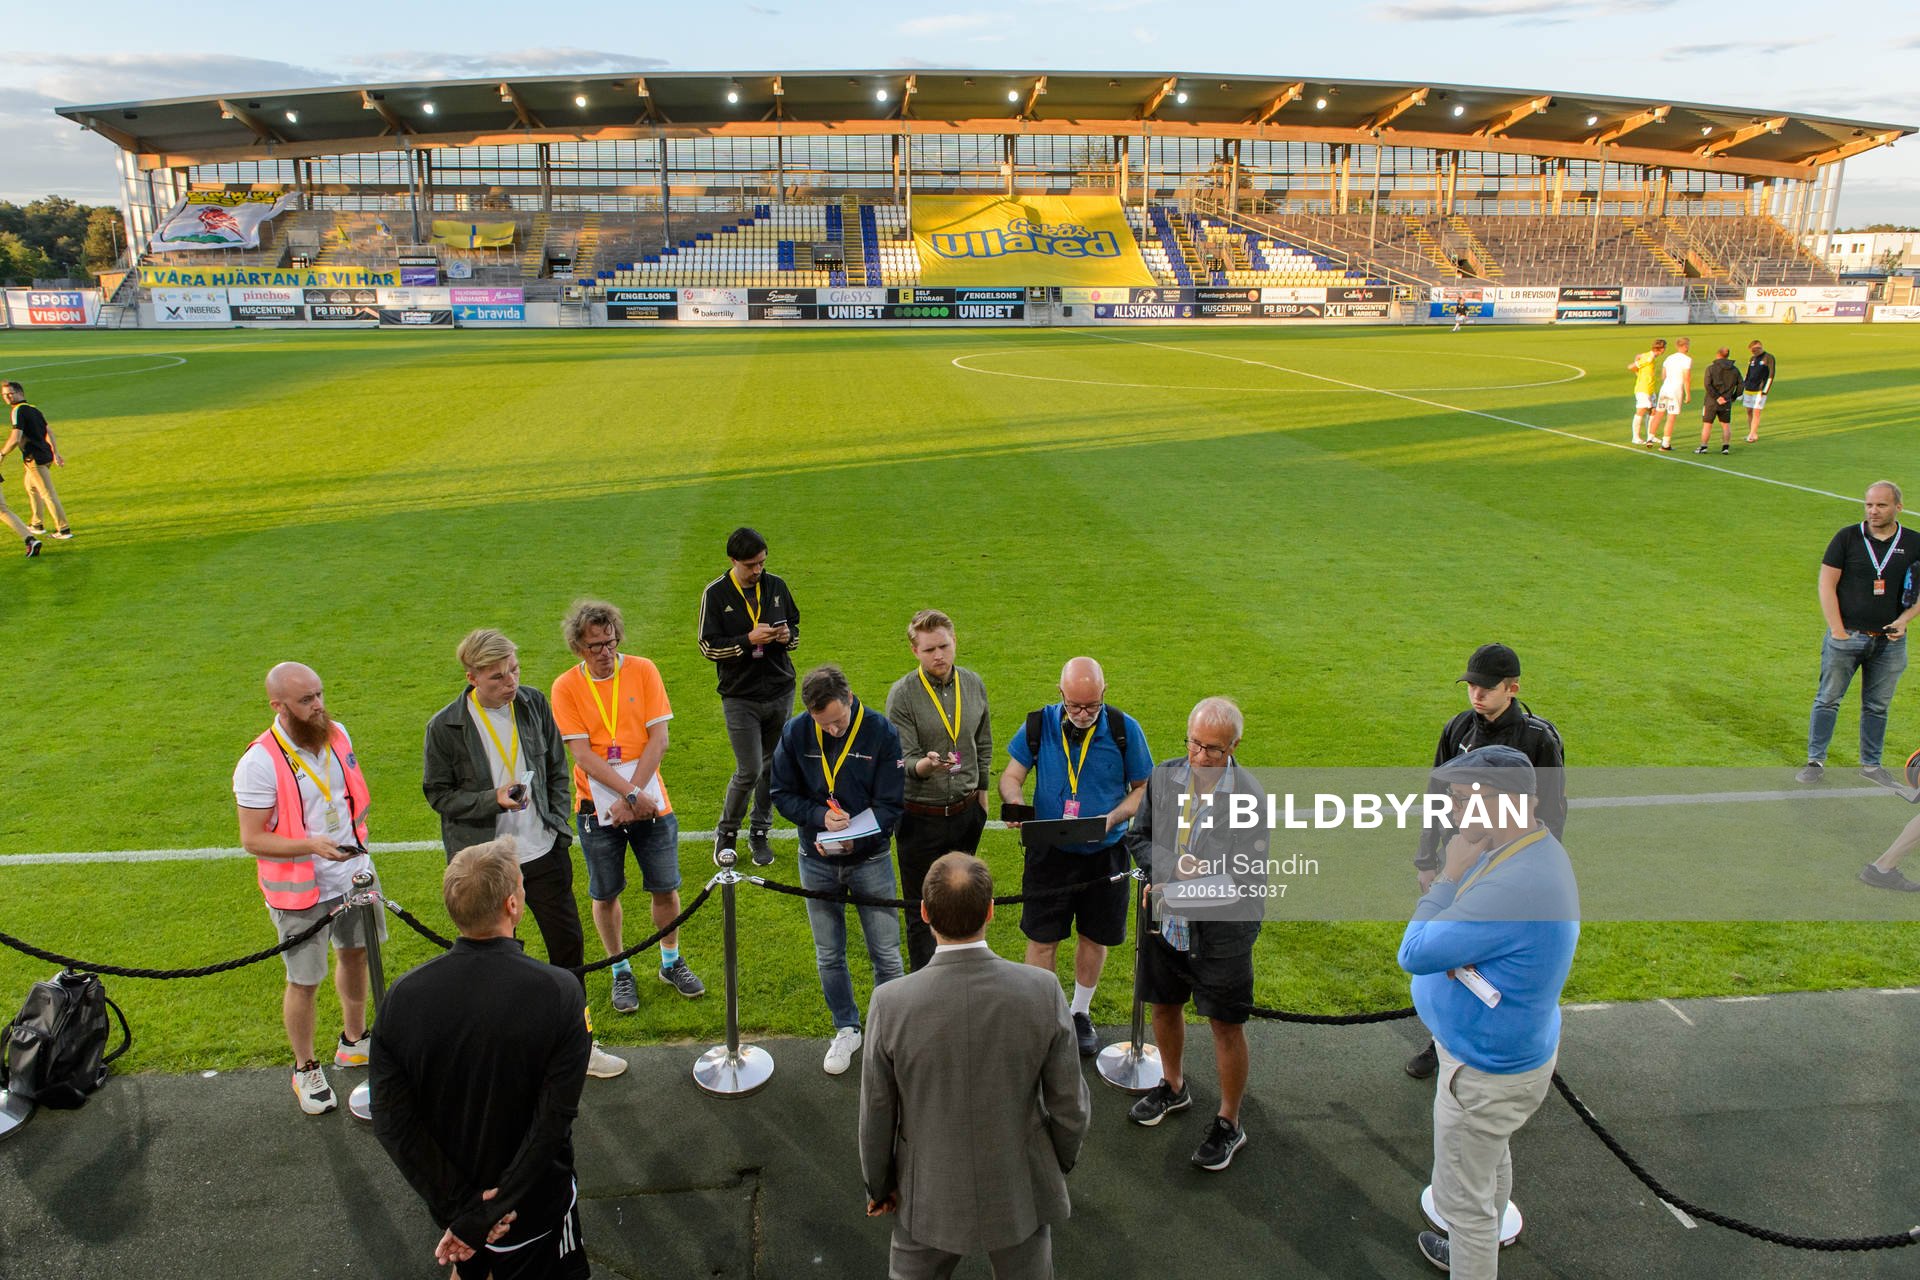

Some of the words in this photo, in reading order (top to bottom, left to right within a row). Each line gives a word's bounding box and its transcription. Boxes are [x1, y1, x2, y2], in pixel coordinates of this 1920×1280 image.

[932, 229, 1121, 258] ullared
[154, 269, 206, 286] VÅRA
[212, 269, 299, 287] HJÄRTAN
[305, 271, 328, 287] ÄR
[331, 272, 350, 286] VI
[243, 290, 291, 303] pinchos
[969, 292, 1018, 300] ENGELSONS
[1522, 291, 1556, 299] REVISION
[1756, 287, 1797, 297] sweaco
[30, 294, 80, 306] SPORT
[183, 306, 222, 314] VINBERGS
[239, 306, 296, 315] HUSCENTRUM
[315, 306, 328, 315] PB
[329, 306, 353, 316] BYGG
[478, 307, 521, 319] bravida
[828, 306, 885, 319] UNIBET
[959, 305, 1014, 319] UNIBET
[1113, 305, 1176, 318] ALLSVENSKAN
[1202, 305, 1252, 313] HUSCENTRUM
[1264, 305, 1275, 313] PB
[1276, 305, 1298, 313] BYGG
[1568, 310, 1613, 318] ENGELSONS
[31, 310, 81, 322] VISION
